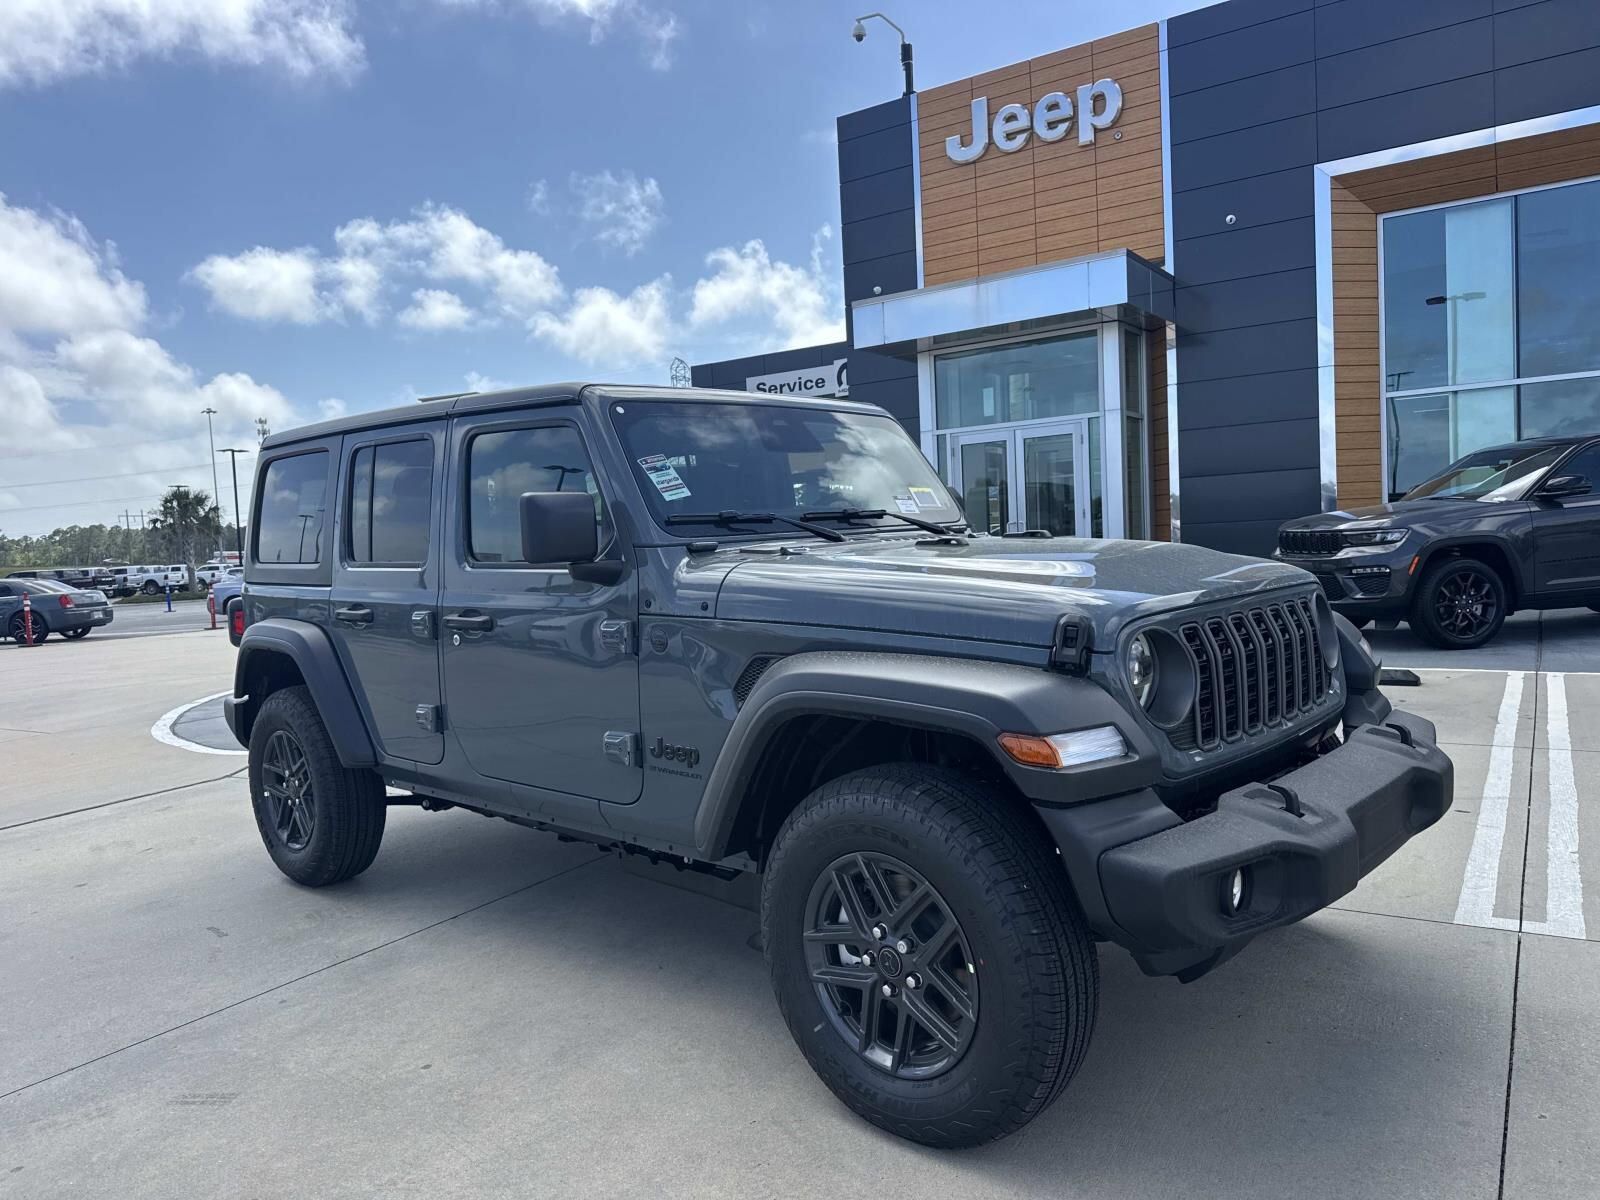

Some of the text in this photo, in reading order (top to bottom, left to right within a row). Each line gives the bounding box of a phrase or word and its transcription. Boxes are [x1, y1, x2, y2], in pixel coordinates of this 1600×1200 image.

[945, 78, 1122, 164] Jeep
[756, 377, 826, 394] Service
[648, 736, 700, 768] Jeep
